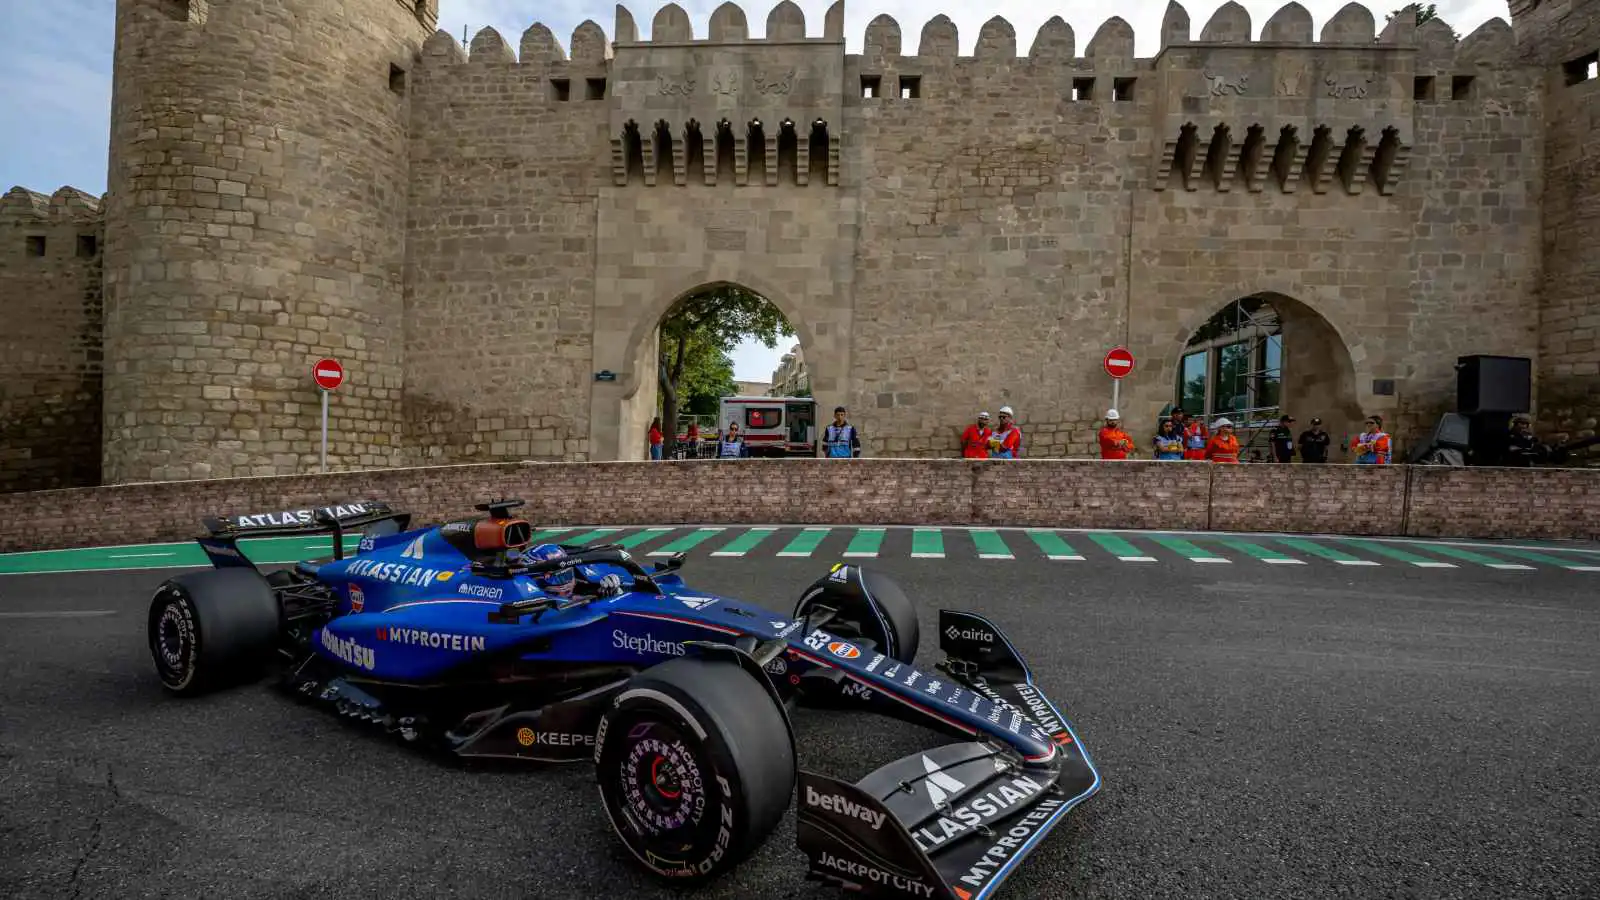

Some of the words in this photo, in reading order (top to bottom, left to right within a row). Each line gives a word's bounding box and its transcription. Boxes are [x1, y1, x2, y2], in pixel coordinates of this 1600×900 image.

[238, 504, 366, 527] ATLASIAN
[360, 539, 375, 550] 23
[345, 559, 438, 588] ATLASSIAN
[468, 585, 503, 600] kraken
[321, 625, 375, 671] KOMATSU
[389, 627, 486, 651] MYPROTEIN
[612, 629, 686, 656] Stephens
[803, 629, 832, 651] 23
[962, 628, 994, 643] airia
[1013, 683, 1063, 734] MYPROTEIN
[536, 732, 595, 747] KEEPE
[672, 739, 705, 798] JACKPOT
[690, 799, 706, 826] CITY
[716, 775, 732, 798] P
[805, 786, 887, 830] betway
[911, 776, 1046, 851] TLASSIAN
[698, 802, 734, 876] ZERO
[960, 799, 1066, 887] MYPROTEIN
[818, 851, 891, 885] JACKPOT
[892, 877, 935, 899] CITY
